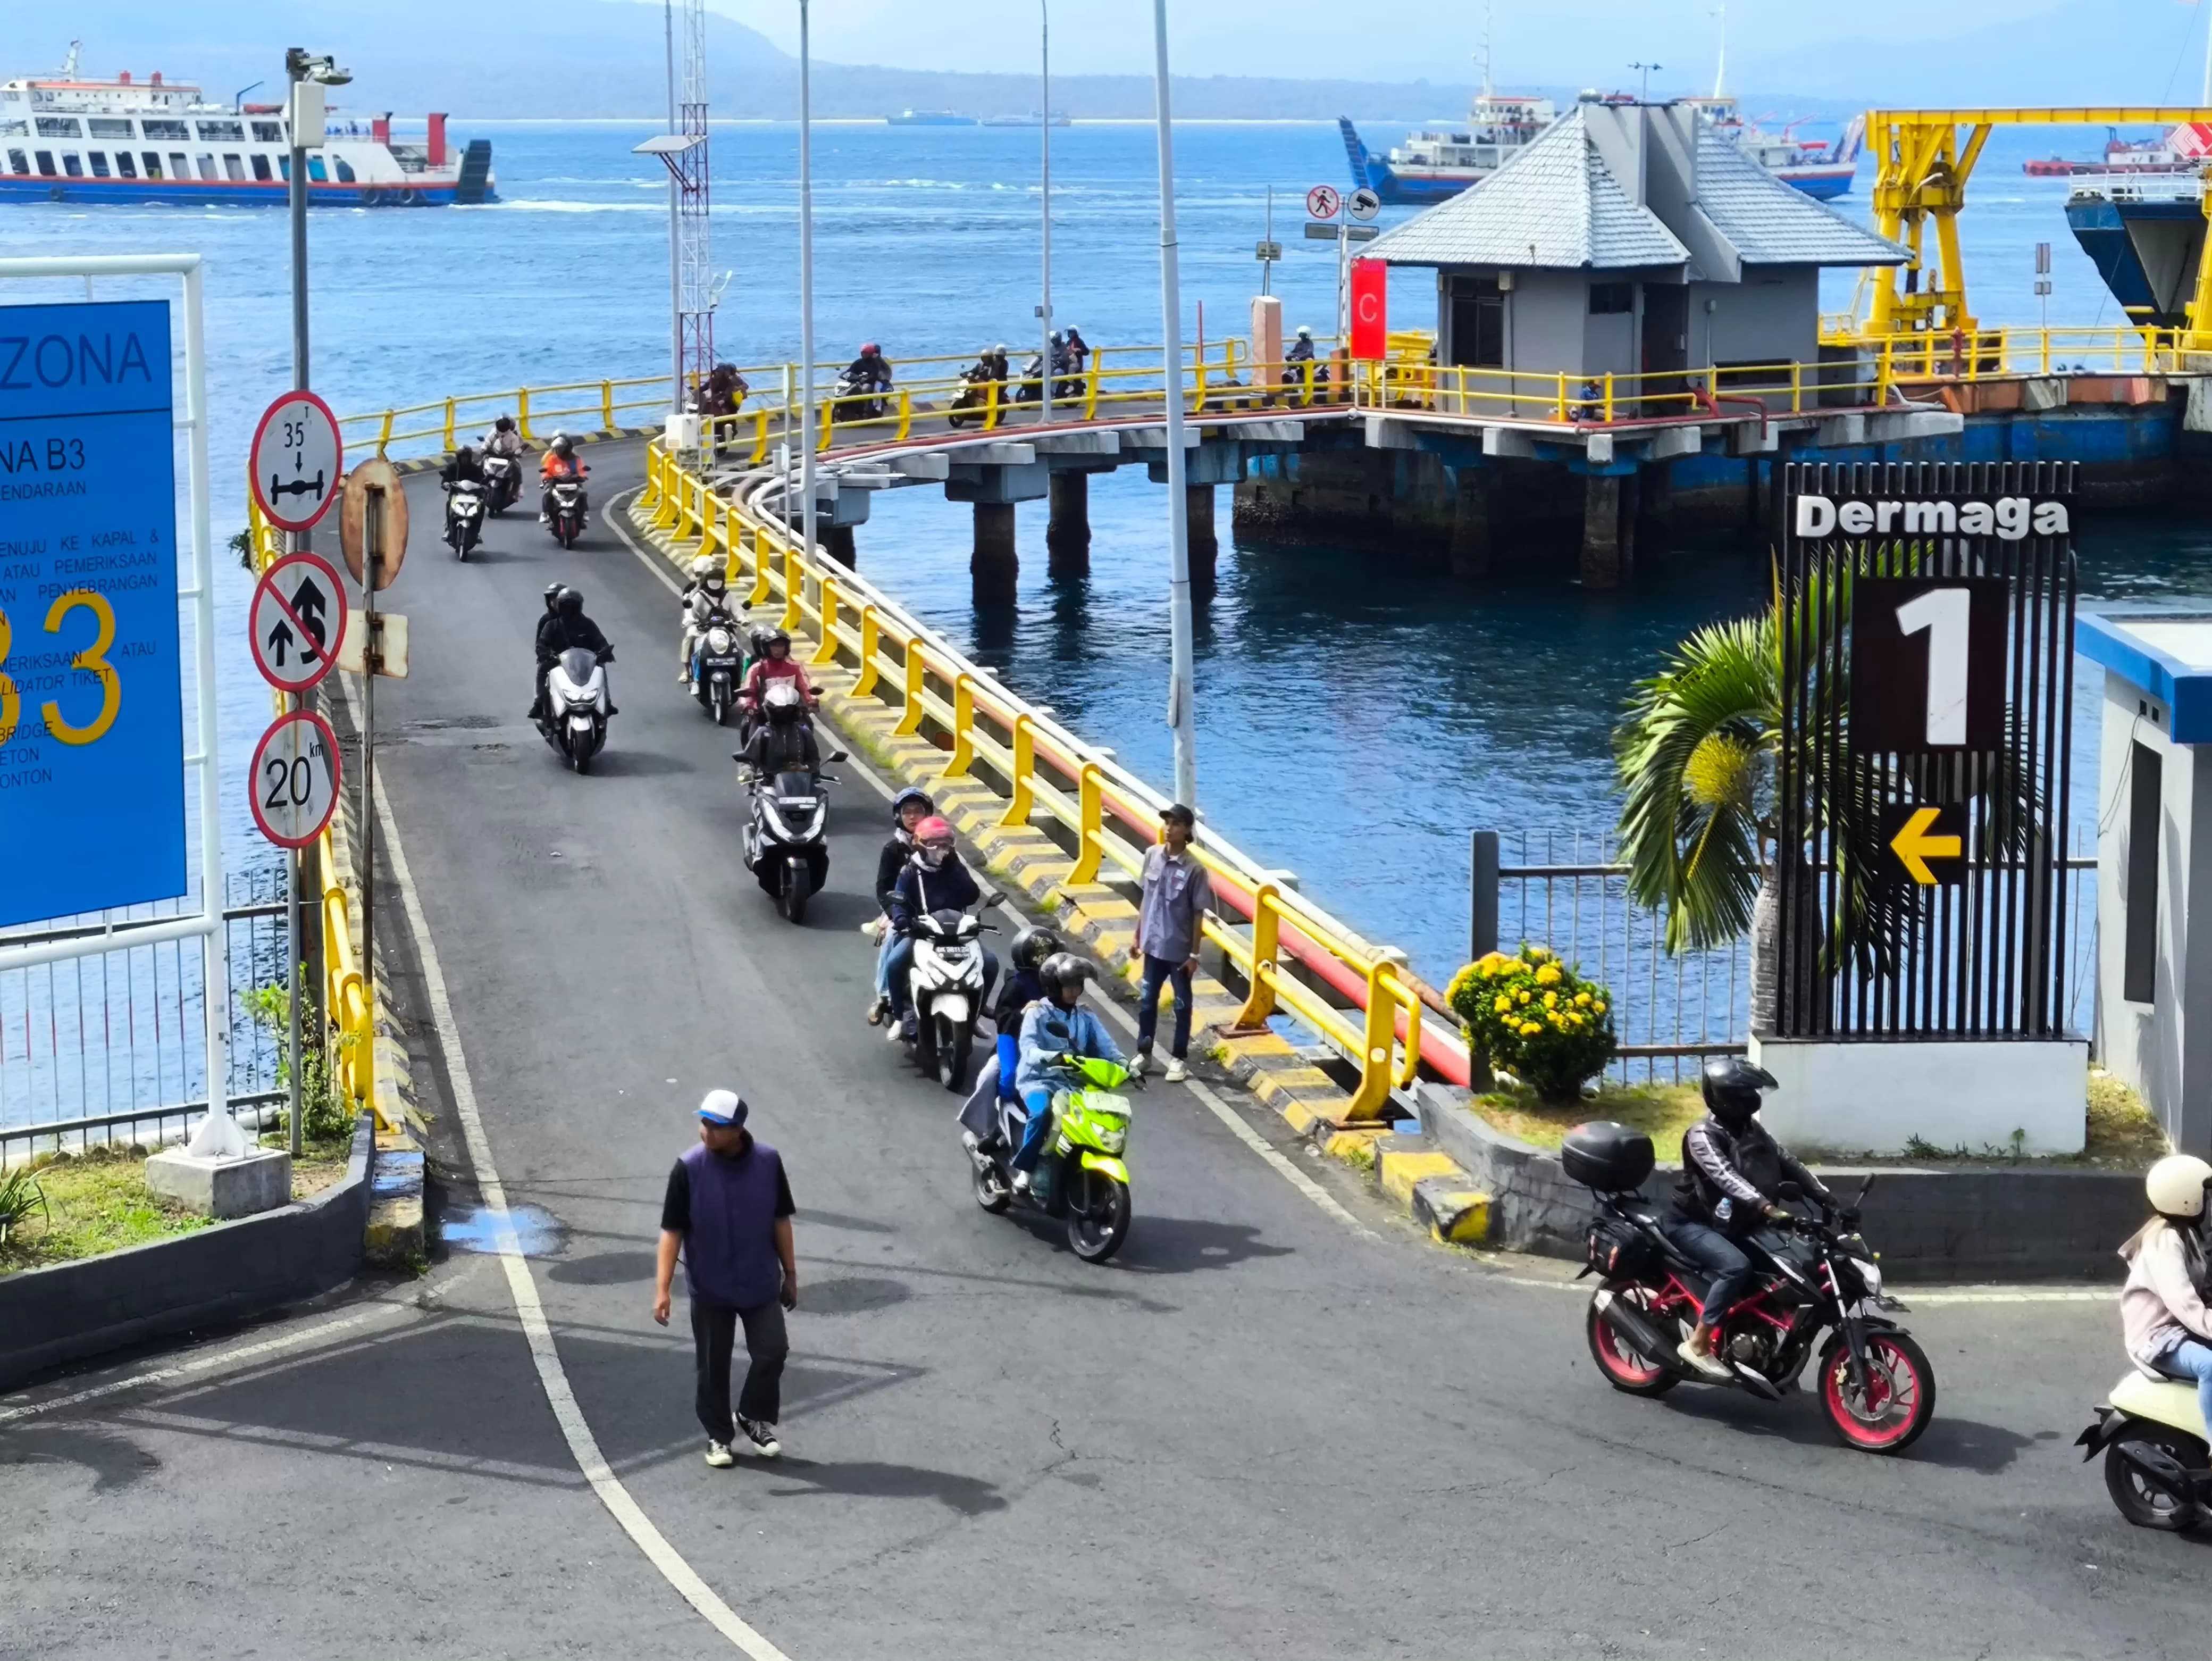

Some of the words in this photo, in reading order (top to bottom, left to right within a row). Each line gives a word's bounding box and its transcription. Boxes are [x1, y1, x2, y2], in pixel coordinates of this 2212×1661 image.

[1359, 293, 1377, 322] C
[0, 332, 152, 390] ZONA
[284, 421, 304, 448] 35
[47, 438, 85, 471] B3
[0, 481, 86, 501] ENDARAAN
[1797, 495, 2069, 540] Dermaga
[60, 536, 79, 551] KE
[91, 531, 137, 548] KAPAL
[3, 562, 40, 581] ATAU
[55, 552, 157, 574] PEMERIKSAAN
[38, 574, 157, 599] PENYEBRANGAN
[121, 641, 156, 658] ATAU
[71, 667, 111, 687] TIKET
[1895, 587, 1971, 745] 1
[309, 742, 324, 758] km
[0, 767, 52, 788] ONTON
[265, 756, 311, 809] 20
